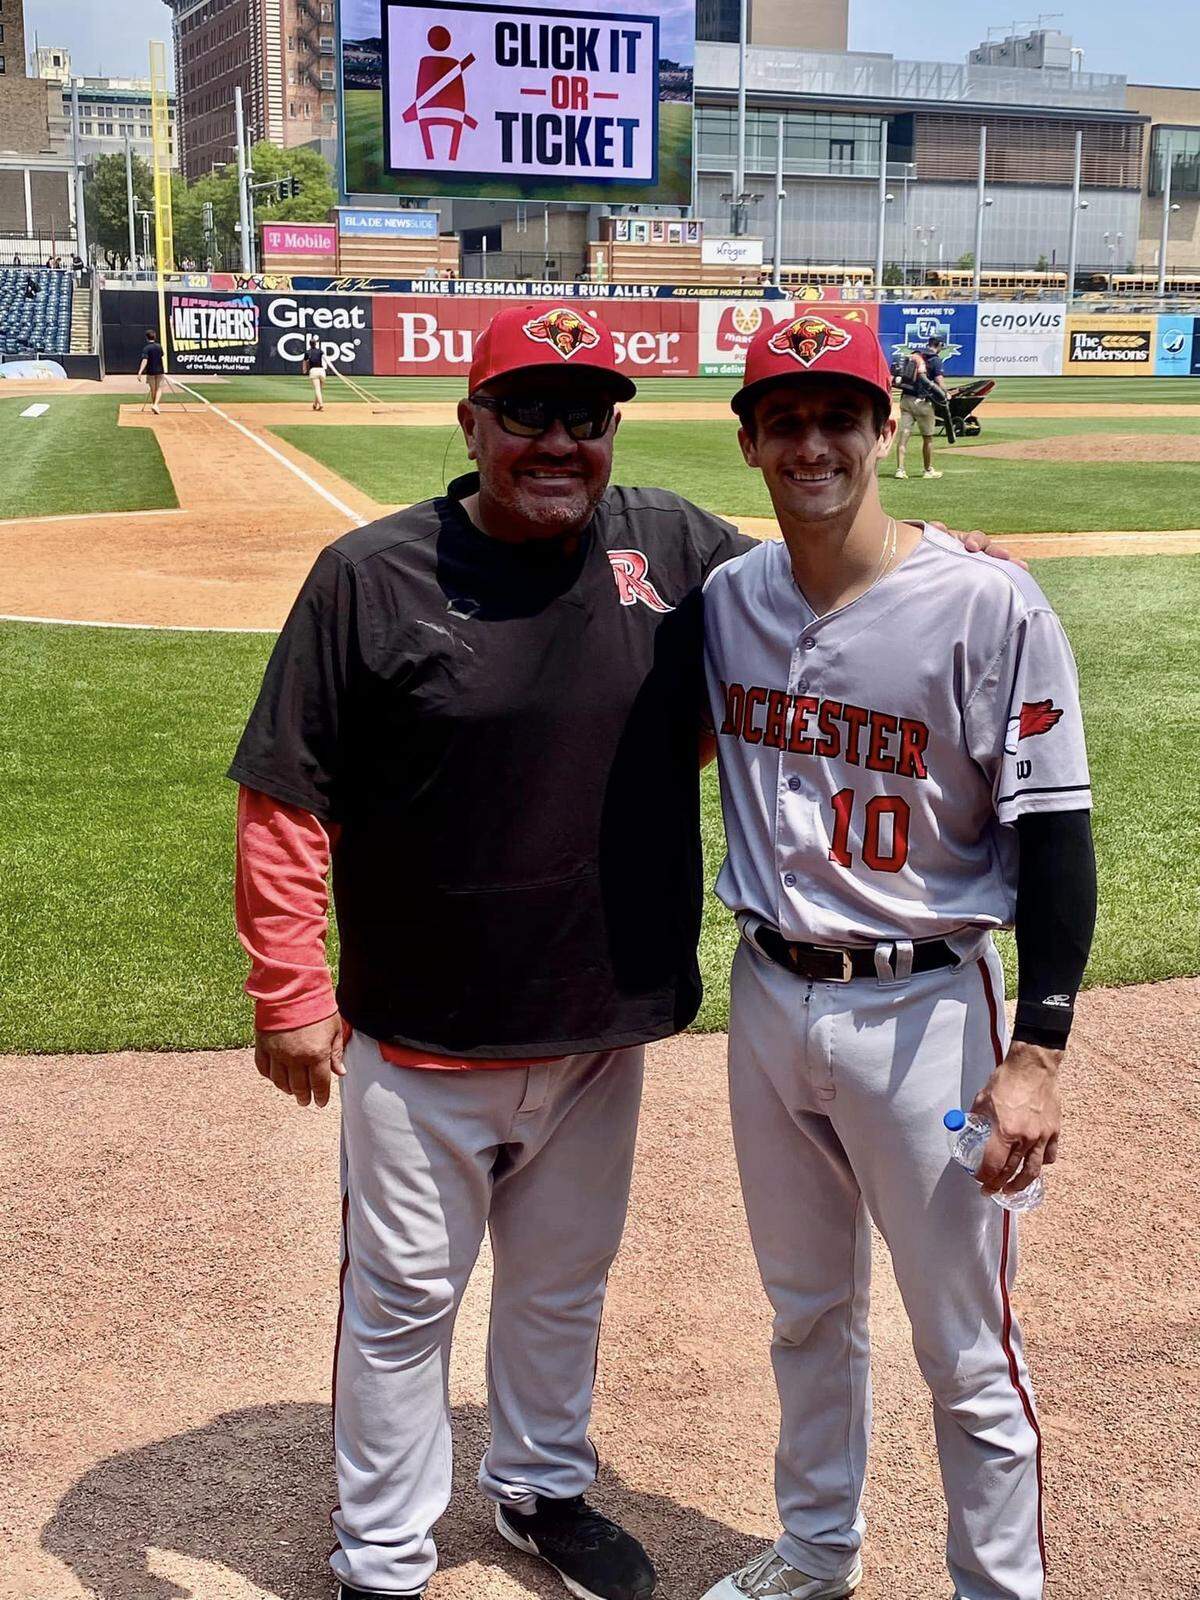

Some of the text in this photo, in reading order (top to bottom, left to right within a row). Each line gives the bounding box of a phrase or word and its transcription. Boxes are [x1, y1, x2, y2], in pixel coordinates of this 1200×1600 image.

[494, 21, 642, 75] CLICK IT
[551, 75, 589, 110] OR
[494, 111, 640, 169] TICKET
[344, 216, 382, 227] BLADE
[284, 233, 331, 249] Mobile
[716, 241, 747, 262] Kroger
[188, 275, 208, 288] 320
[411, 280, 660, 298] MIKE HESSMAN HOME RUN ALLEY
[687, 288, 719, 297] CAREER
[719, 289, 742, 297] HOME
[267, 298, 366, 329] Great
[980, 312, 1061, 330] cenovus
[174, 307, 255, 340] METZGERS
[1072, 333, 1100, 347] The
[176, 354, 256, 363] OFFICIAL PRINTER
[979, 355, 1039, 363] cenovus.com
[1072, 346, 1148, 361] Andersons
[704, 366, 719, 374] we
[607, 549, 676, 613] R
[720, 680, 929, 779] OCHESTER
[828, 788, 910, 874] 10
